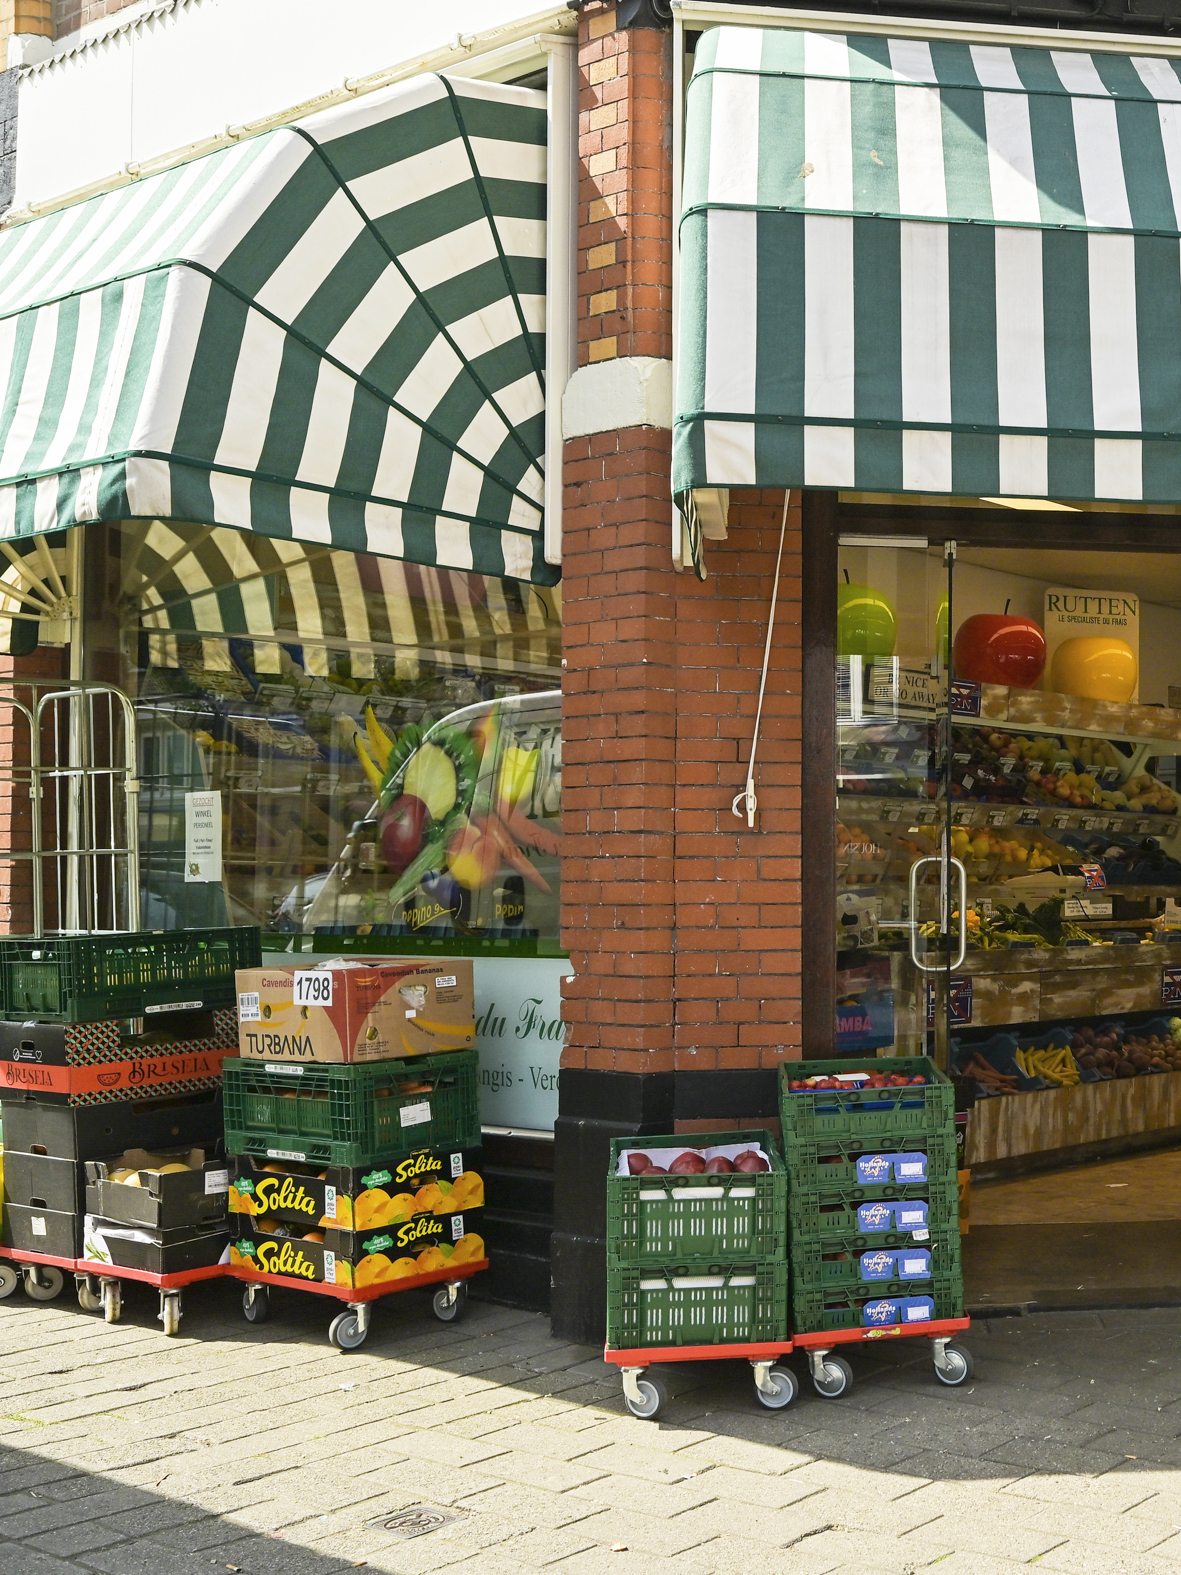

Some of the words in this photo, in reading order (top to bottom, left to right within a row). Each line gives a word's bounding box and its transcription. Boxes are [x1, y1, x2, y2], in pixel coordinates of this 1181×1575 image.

[1047, 594, 1138, 616] RUTTEN
[1058, 614, 1065, 623] LE
[1067, 615, 1101, 625] SPECIALISTE
[1102, 617, 1110, 625] DU
[1111, 618, 1128, 626] FRAIS
[904, 675, 928, 689] NICE
[911, 691, 938, 704] AWAY
[194, 810, 213, 818] WINKEL
[415, 967, 444, 975] Bananas
[296, 977, 331, 1001] 1798
[475, 1003, 507, 1038] du
[245, 1033, 315, 1056] TURBANA
[6, 1063, 53, 1086] BRISEIA
[128, 1057, 211, 1084] BRISEIA
[479, 1063, 513, 1092] ngis
[395, 1154, 442, 1183] Solita
[255, 1177, 316, 1215] Solita
[397, 1218, 444, 1248] Solita
[256, 1241, 315, 1279] Solita
